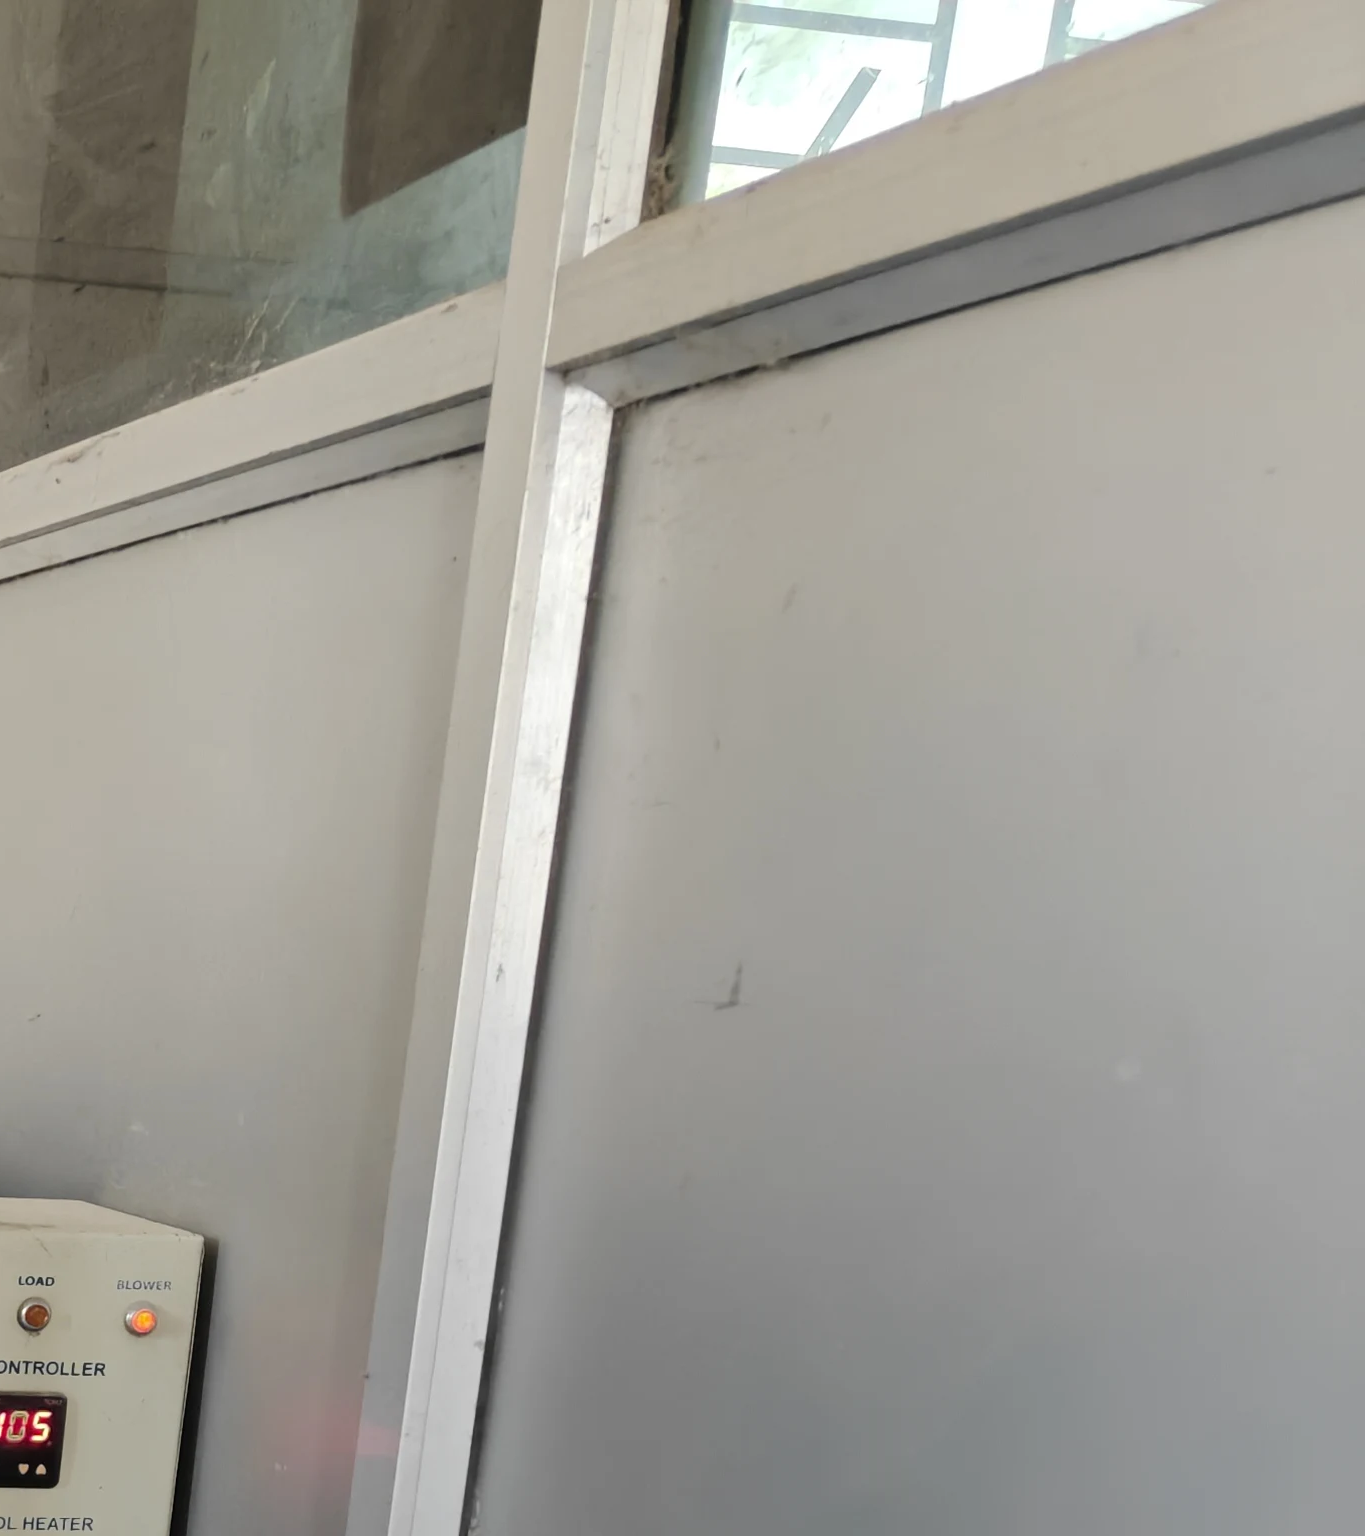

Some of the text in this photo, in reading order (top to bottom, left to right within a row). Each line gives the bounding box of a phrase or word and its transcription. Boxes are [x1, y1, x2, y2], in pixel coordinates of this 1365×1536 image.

[18, 1275, 55, 1287] LOAD
[116, 1279, 172, 1291] BLOWER
[23, 1515, 94, 1532] HEATER
